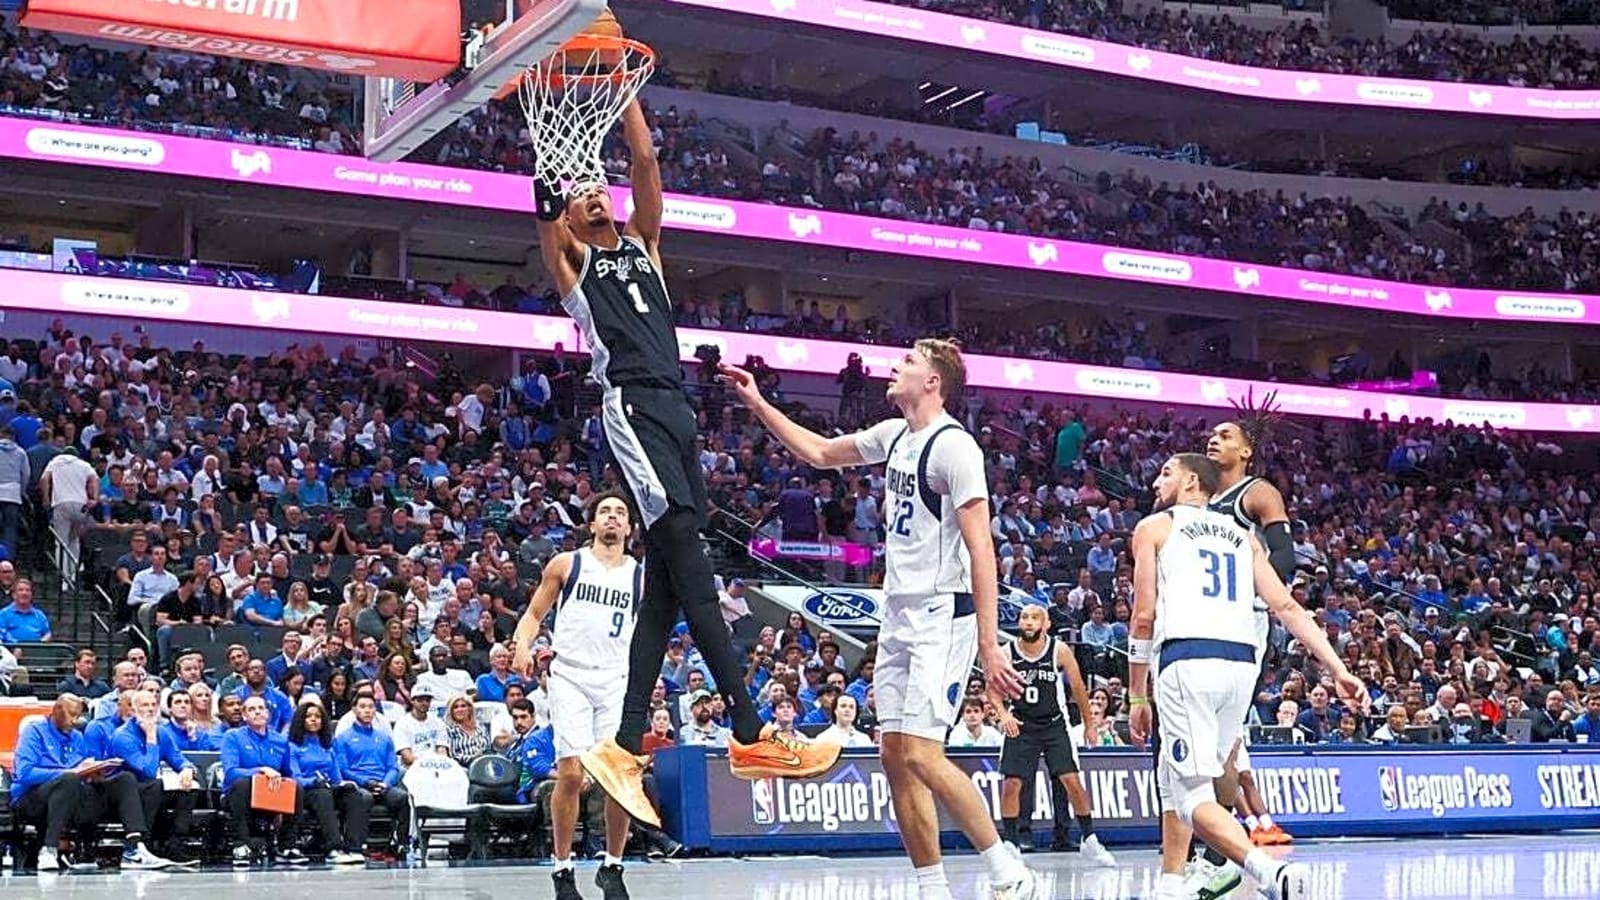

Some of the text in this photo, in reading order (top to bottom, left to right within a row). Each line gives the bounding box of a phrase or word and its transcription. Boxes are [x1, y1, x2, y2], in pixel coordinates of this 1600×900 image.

[334, 166, 473, 193] Game plan your ride
[627, 283, 650, 313] 1
[1180, 521, 1244, 549] THOMPSON
[1198, 549, 1237, 602] 31
[576, 582, 631, 609] DALLAS
[816, 593, 866, 617] Ford
[608, 611, 625, 638] 9
[1025, 686, 1039, 704] 0
[1250, 767, 1345, 814] URTSIDE
[1399, 766, 1513, 817] League Pass
[1536, 764, 1600, 809] STREA
[776, 778, 869, 831] League
